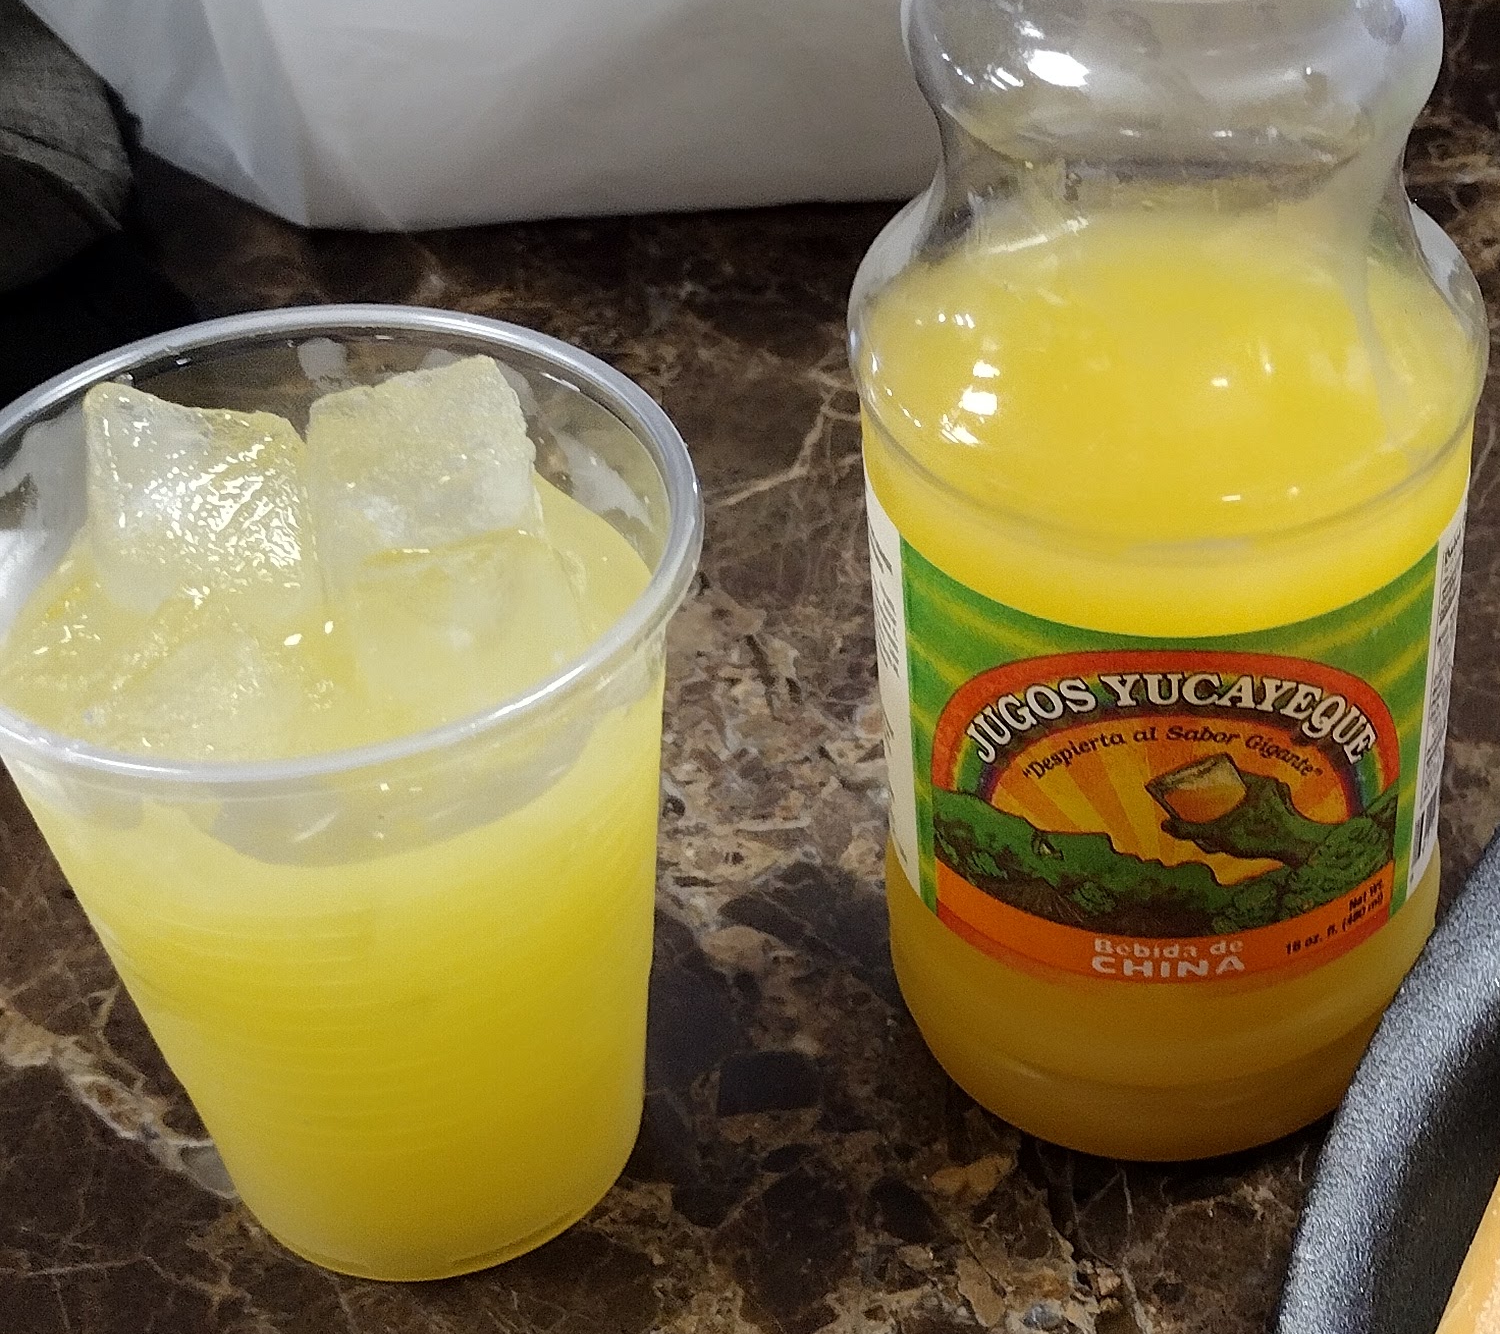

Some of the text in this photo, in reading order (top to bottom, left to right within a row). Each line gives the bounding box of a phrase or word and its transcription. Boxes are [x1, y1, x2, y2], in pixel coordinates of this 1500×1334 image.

[966, 677, 1099, 765] JUGOS
[1099, 672, 1377, 765] YUCAYEQUE
[1133, 726, 1157, 744] al
[1166, 725, 1240, 745] Sabor
[1094, 938, 1244, 959] Bebida de
[1092, 955, 1246, 978] CHINA
